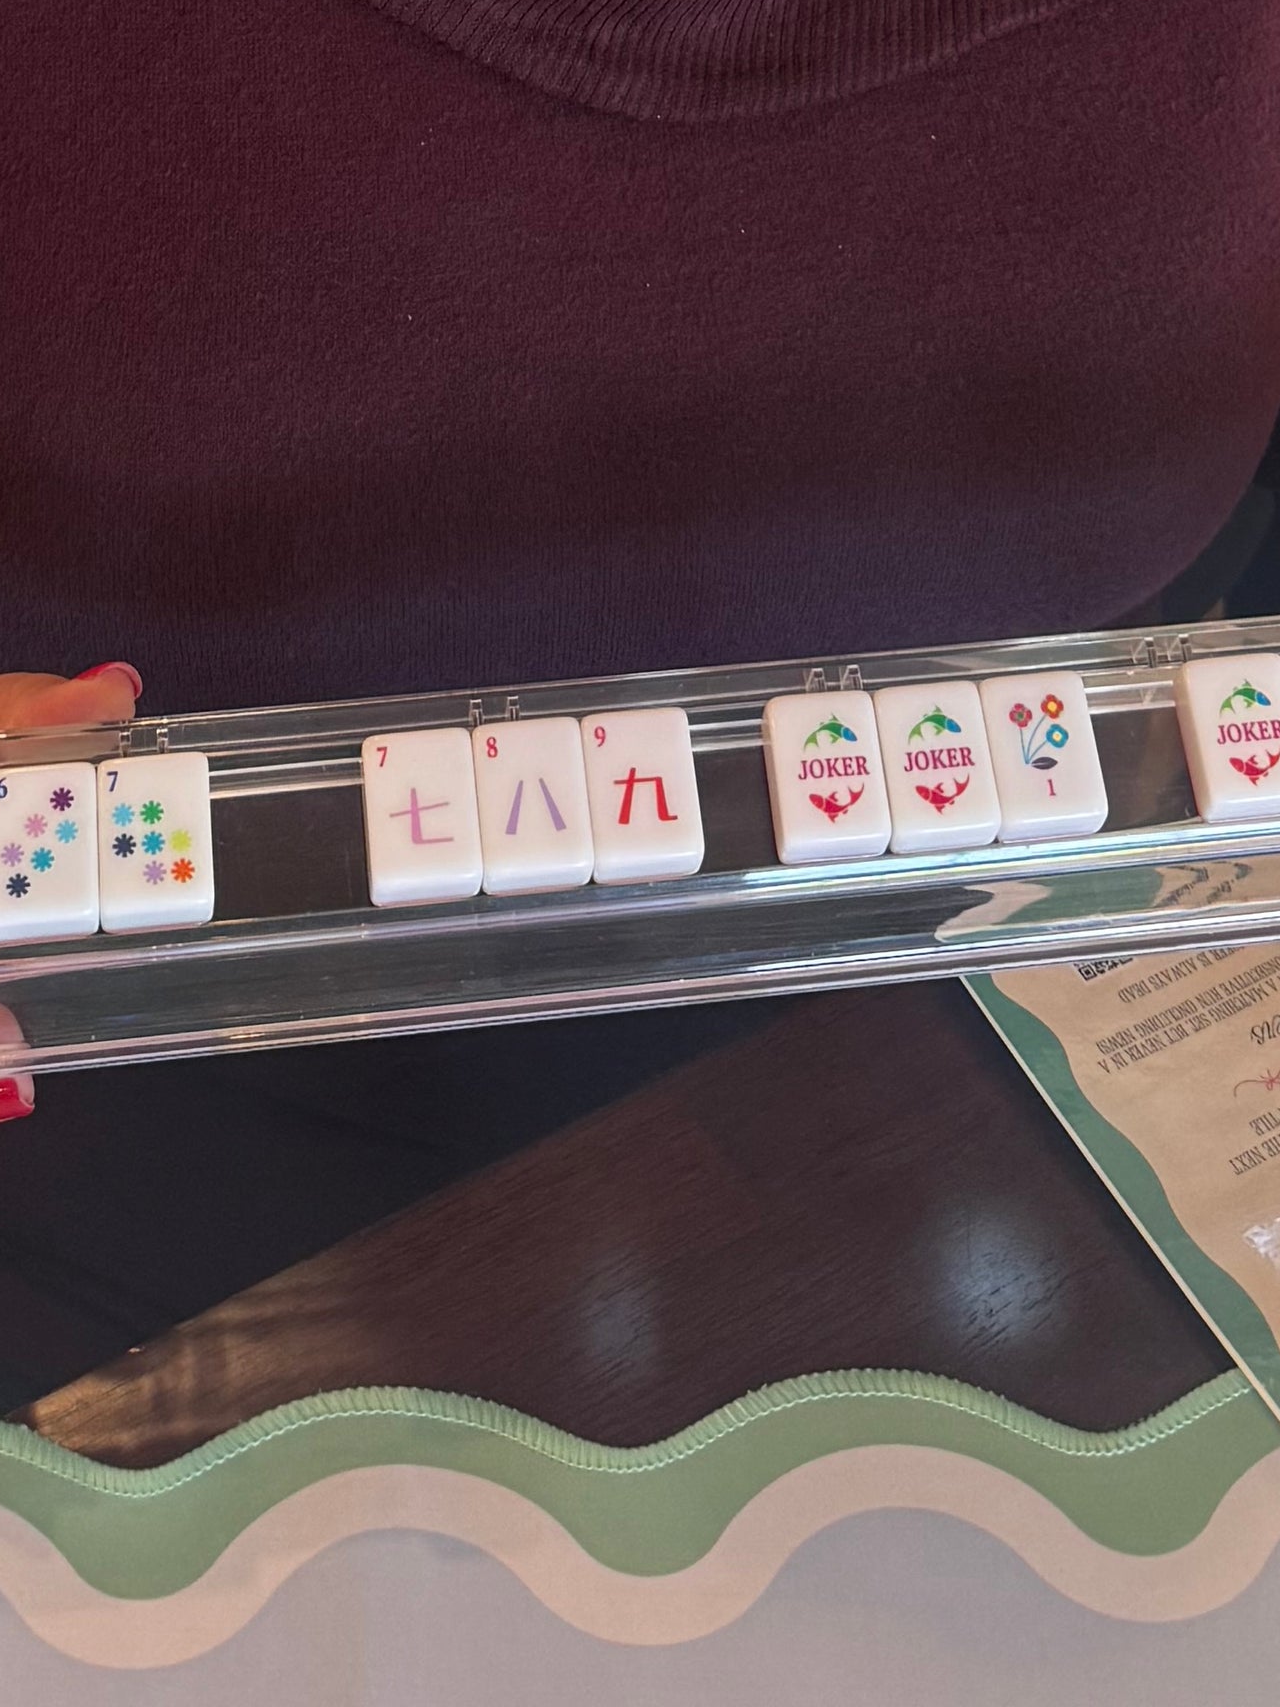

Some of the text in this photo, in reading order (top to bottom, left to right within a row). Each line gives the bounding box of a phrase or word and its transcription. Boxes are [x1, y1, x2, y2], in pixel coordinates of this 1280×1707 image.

[594, 726, 606, 747] 9
[377, 747, 388, 767] 7
[486, 737, 498, 758] 8
[798, 756, 870, 780] JOKER
[904, 746, 976, 772] JOKER
[107, 771, 119, 792] 7
[1047, 779, 1056, 796] 1
[505, 777, 567, 835] 八
[613, 767, 678, 824] 九
[389, 787, 455, 845] 七
[1195, 951, 1213, 967] IS
[1147, 957, 1197, 990] ALWAYS
[1117, 979, 1151, 1003] DEAD
[1264, 978, 1278, 991] A
[1194, 986, 1222, 1007] RUN
[1207, 984, 1268, 1021] MATCHING
[1163, 1023, 1189, 1044] BUT
[1124, 1034, 1167, 1062] NEVER
[1096, 1058, 1111, 1074] A
[1109, 1052, 1128, 1070] IN
[1228, 1145, 1266, 1175] NEXT
